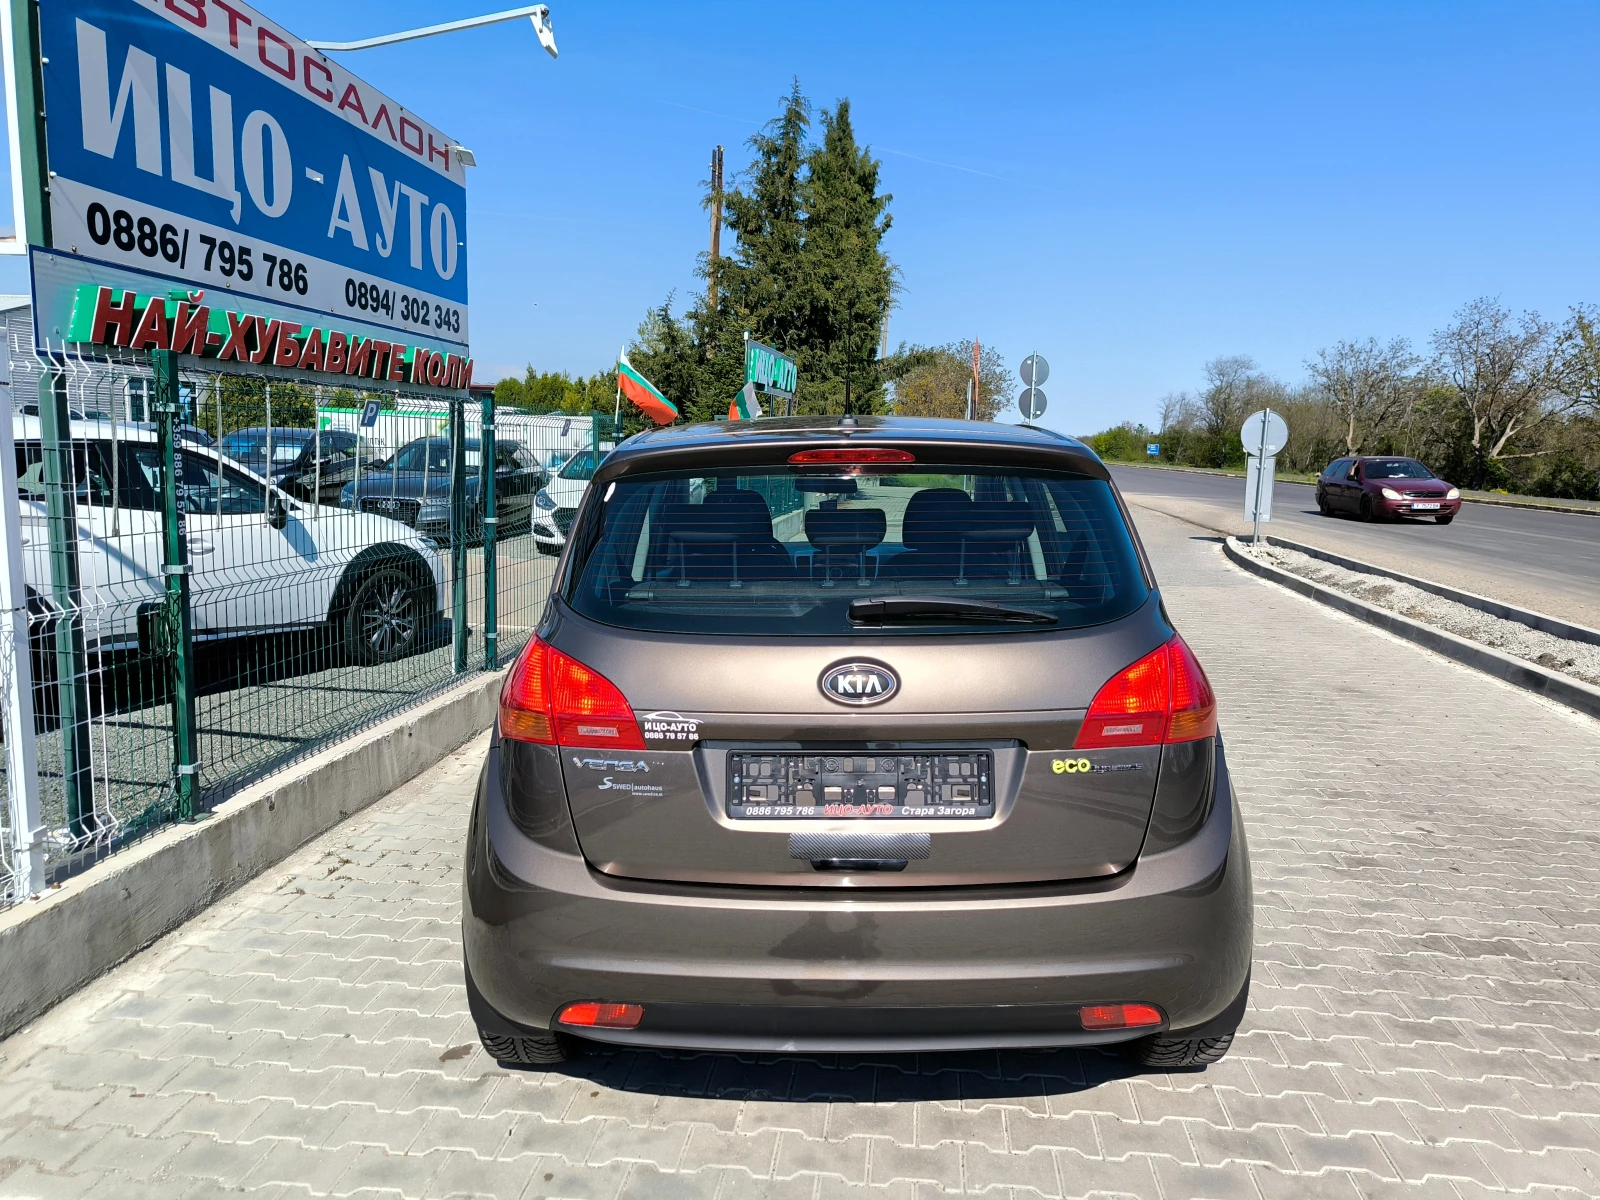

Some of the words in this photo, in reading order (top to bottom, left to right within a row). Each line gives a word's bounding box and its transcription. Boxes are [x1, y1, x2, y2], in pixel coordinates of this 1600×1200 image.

[153, 0, 450, 171] ВТОСАЛОН
[86, 202, 189, 270] 0886/
[199, 236, 254, 282] 795
[262, 253, 309, 296] 786
[345, 278, 396, 317] 0894/
[400, 294, 430, 327] 302
[434, 304, 461, 334] 343
[90, 286, 407, 381] НАЙ-ХУБАВИТЕ
[410, 346, 474, 390] КОЛИ
[364, 404, 377, 424] P
[172, 416, 182, 449] +359
[173, 452, 183, 477] 886
[175, 480, 184, 497] 79
[176, 501, 186, 516] 57
[178, 520, 187, 536] 86
[836, 674, 883, 694] KIA
[644, 721, 697, 732] ИЦО-АУТО
[644, 731, 664, 739] 0886
[665, 732, 676, 740] 79
[677, 732, 687, 740] 57
[746, 806, 771, 815] 0886
[774, 806, 793, 816] 795
[795, 806, 815, 816] 786
[823, 804, 893, 816] ИЦО-АУТО
[901, 806, 934, 817] Стара
[937, 806, 975, 817] Загора
